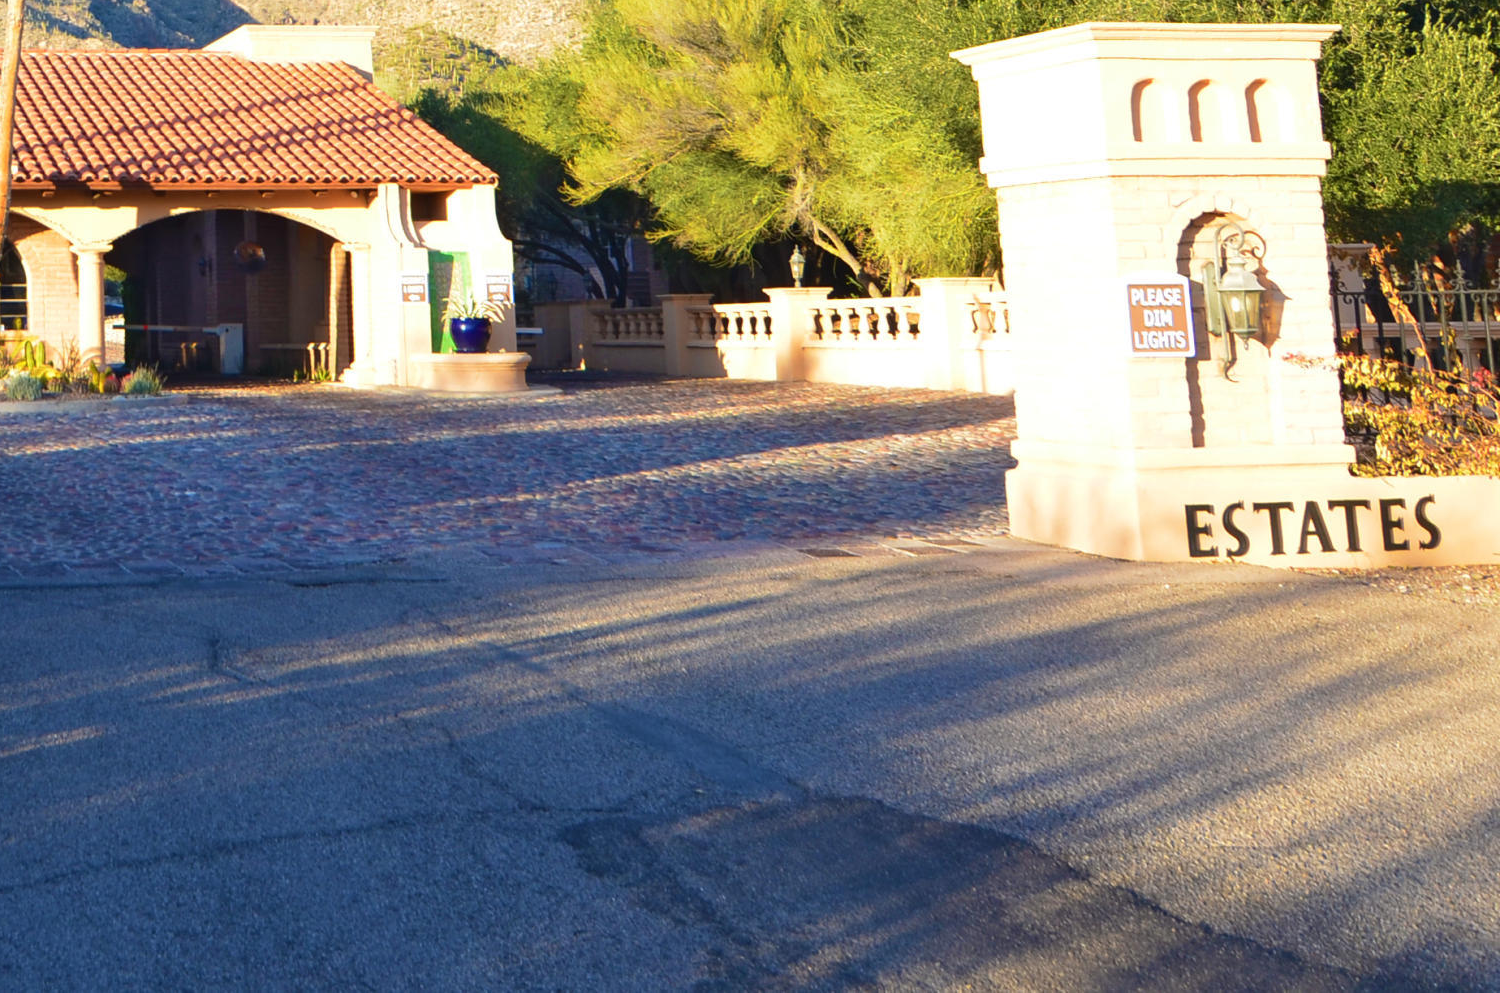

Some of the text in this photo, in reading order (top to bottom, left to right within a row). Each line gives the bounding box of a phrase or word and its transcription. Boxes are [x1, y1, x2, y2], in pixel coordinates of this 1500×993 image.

[1131, 288, 1183, 306] PLEASE
[1143, 309, 1173, 327] DIM
[1134, 330, 1187, 349] LIGHTS
[1185, 494, 1442, 558] ESTATES
